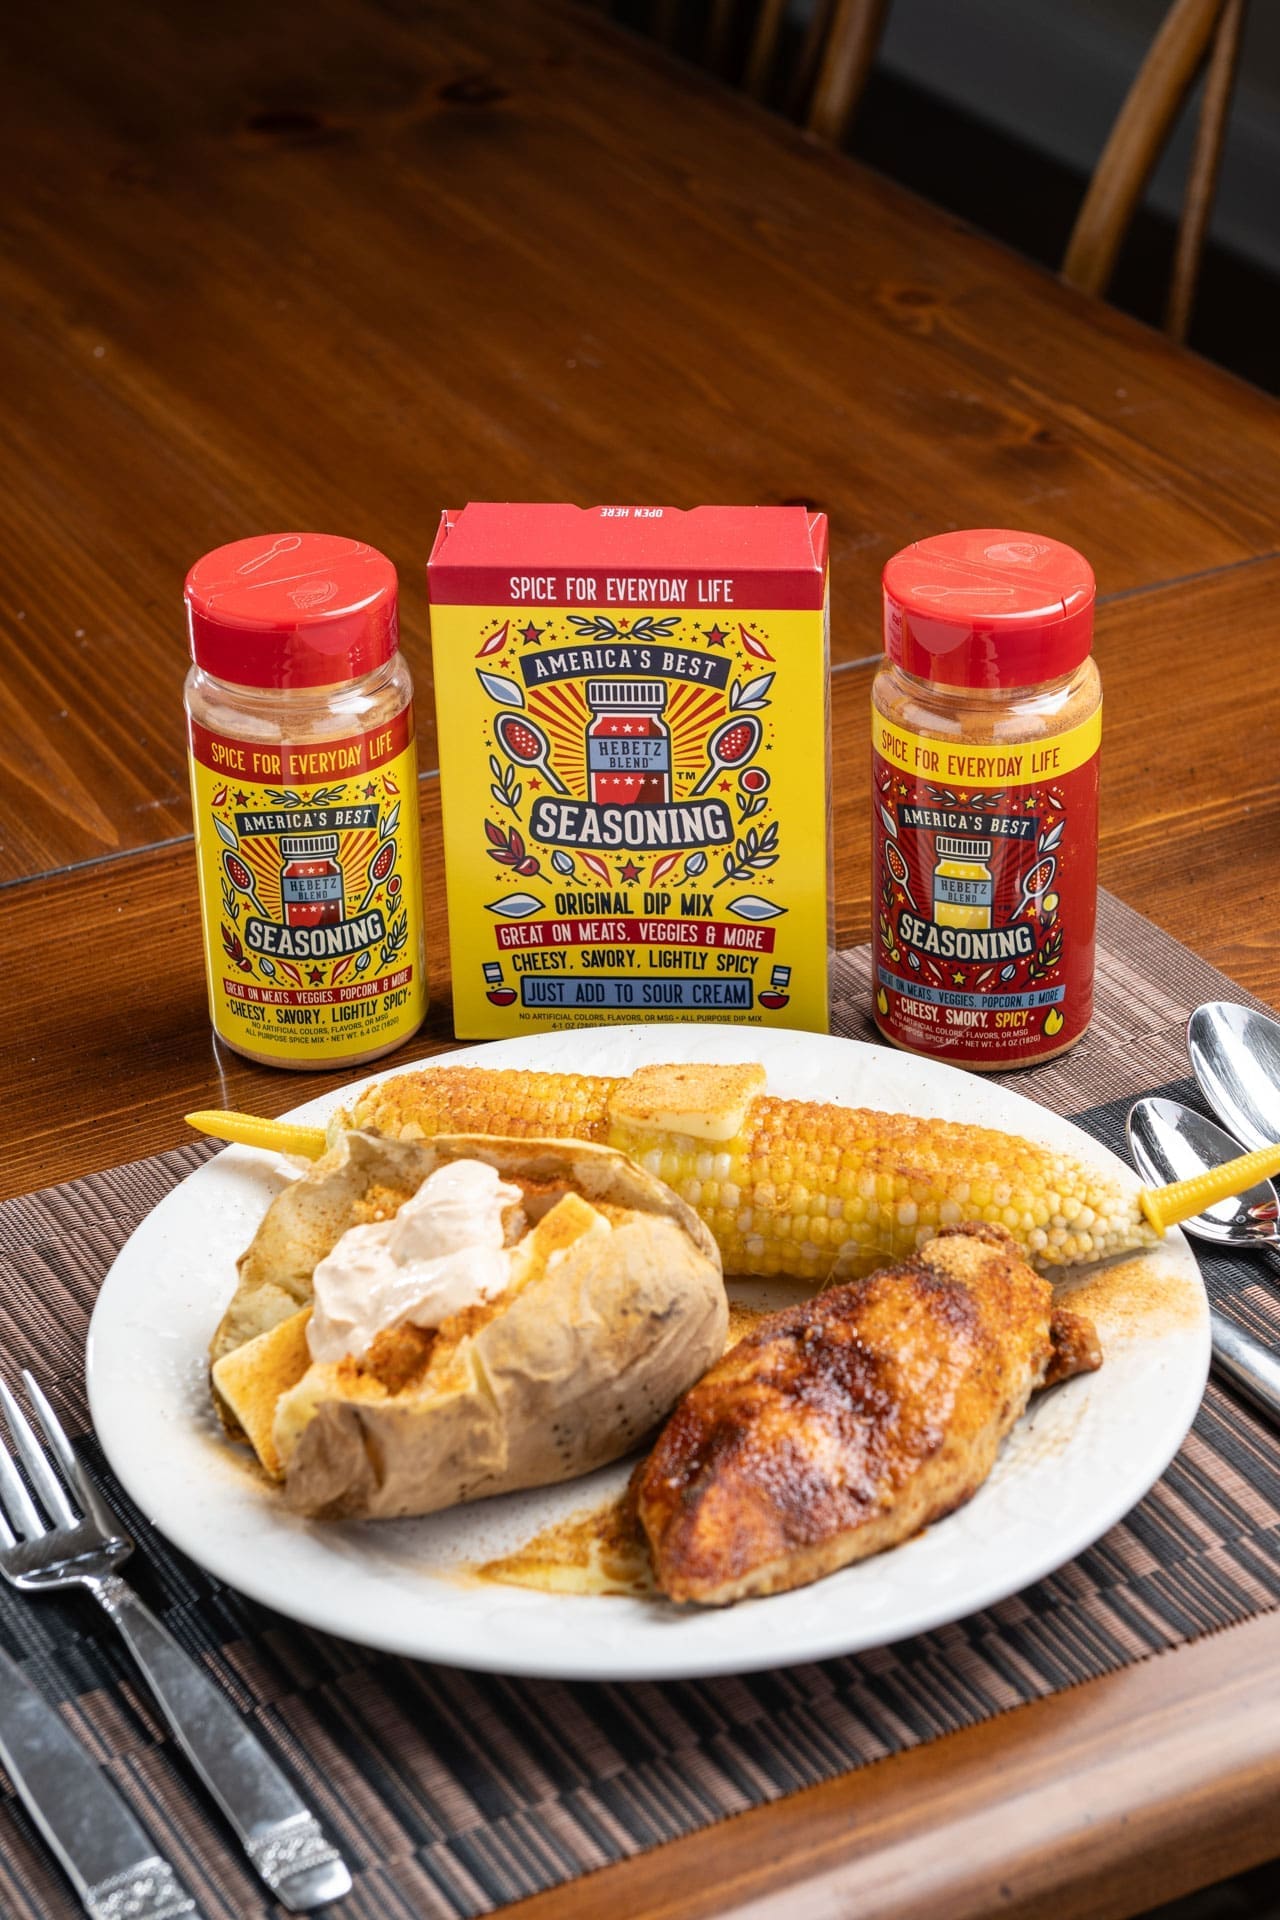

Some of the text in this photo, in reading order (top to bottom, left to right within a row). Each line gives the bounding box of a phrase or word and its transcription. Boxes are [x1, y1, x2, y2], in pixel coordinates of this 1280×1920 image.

[600, 508, 663, 518] OPEN HERE
[510, 577, 734, 602] SPICE FOR EVERYDAY LIFE
[535, 649, 717, 680] AMERICA'S BEST
[211, 730, 393, 775] SPICE FOR EVERYDAY LIFE
[599, 741, 661, 756] HEBETZ
[882, 729, 1061, 778] SPICE FOR EVERYDAY LIFE
[244, 809, 371, 832] AMERICA'S BEST
[536, 802, 727, 845] SEASONING
[903, 808, 1030, 838] AMERICA'S BEST
[290, 878, 337, 892] HEBETZ
[298, 891, 328, 900] BLEND
[941, 880, 988, 895] HEBETZ
[948, 892, 977, 903] BLEND
[555, 892, 714, 917] ORIGINAL DIP MIX
[248, 913, 383, 957] SEASONING
[500, 925, 543, 946] GREAT
[552, 923, 572, 942] ON
[639, 922, 698, 943] VEGGIES
[706, 925, 716, 945] &
[724, 927, 765, 949] MORE
[900, 913, 1032, 960] SEASONING
[649, 950, 708, 970] LIGHTLY
[717, 954, 759, 975] SPICY
[225, 981, 244, 998] GREAT
[248, 988, 258, 1000] ON
[383, 978, 389, 991] &
[391, 969, 408, 987] MORE
[528, 982, 746, 1004] JUST ADD TO SOUR CREAM
[896, 979, 905, 992] ON
[1028, 994, 1034, 1006] &
[1039, 989, 1059, 1004] MORE
[331, 999, 378, 1022] LIGHTLY
[383, 987, 407, 1011] SPICY
[251, 1021, 261, 1029] NO
[262, 1024, 298, 1034] ARTIFICIAL
[365, 1018, 374, 1026] OR
[375, 1013, 388, 1022] MSG
[890, 1017, 898, 1027] ALL
[898, 1022, 923, 1038] PURPOSE
[925, 1033, 944, 1043] SPICE
[946, 1038, 959, 1046] MIX
[894, 1011, 902, 1019] NO
[903, 1015, 934, 1032] ARTIFICIAL
[1013, 1029, 1028, 1037] MSG
[995, 1011, 1029, 1028] SPICY
[246, 1027, 256, 1037] ALL
[258, 1031, 288, 1042] PURPOSE
[310, 1036, 324, 1044] MIX
[331, 1034, 344, 1042] NET
[371, 1024, 380, 1033] OZ
